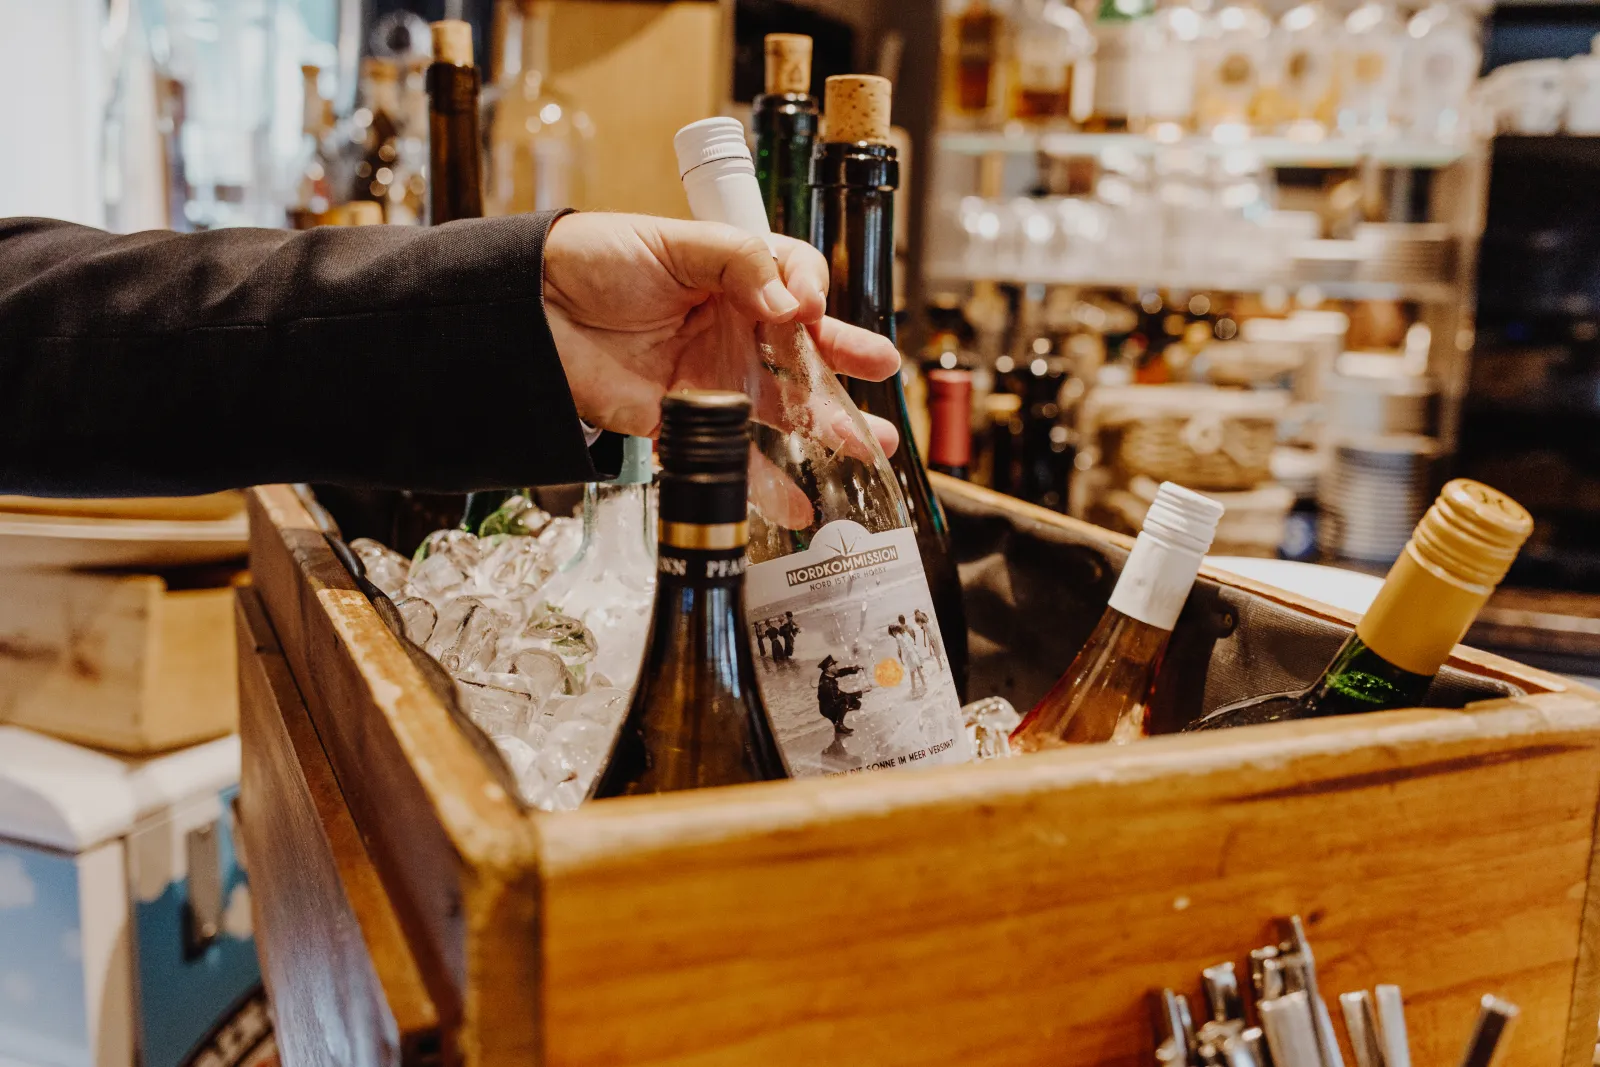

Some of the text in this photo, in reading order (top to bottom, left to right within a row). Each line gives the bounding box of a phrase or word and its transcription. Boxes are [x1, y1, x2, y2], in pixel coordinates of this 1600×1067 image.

[787, 547, 897, 586] NORDKOMMISSION
[809, 580, 832, 592] NORD
[834, 576, 846, 586] IST
[866, 758, 896, 772] SONNE
[898, 755, 907, 766] IM
[909, 750, 926, 761] MEER
